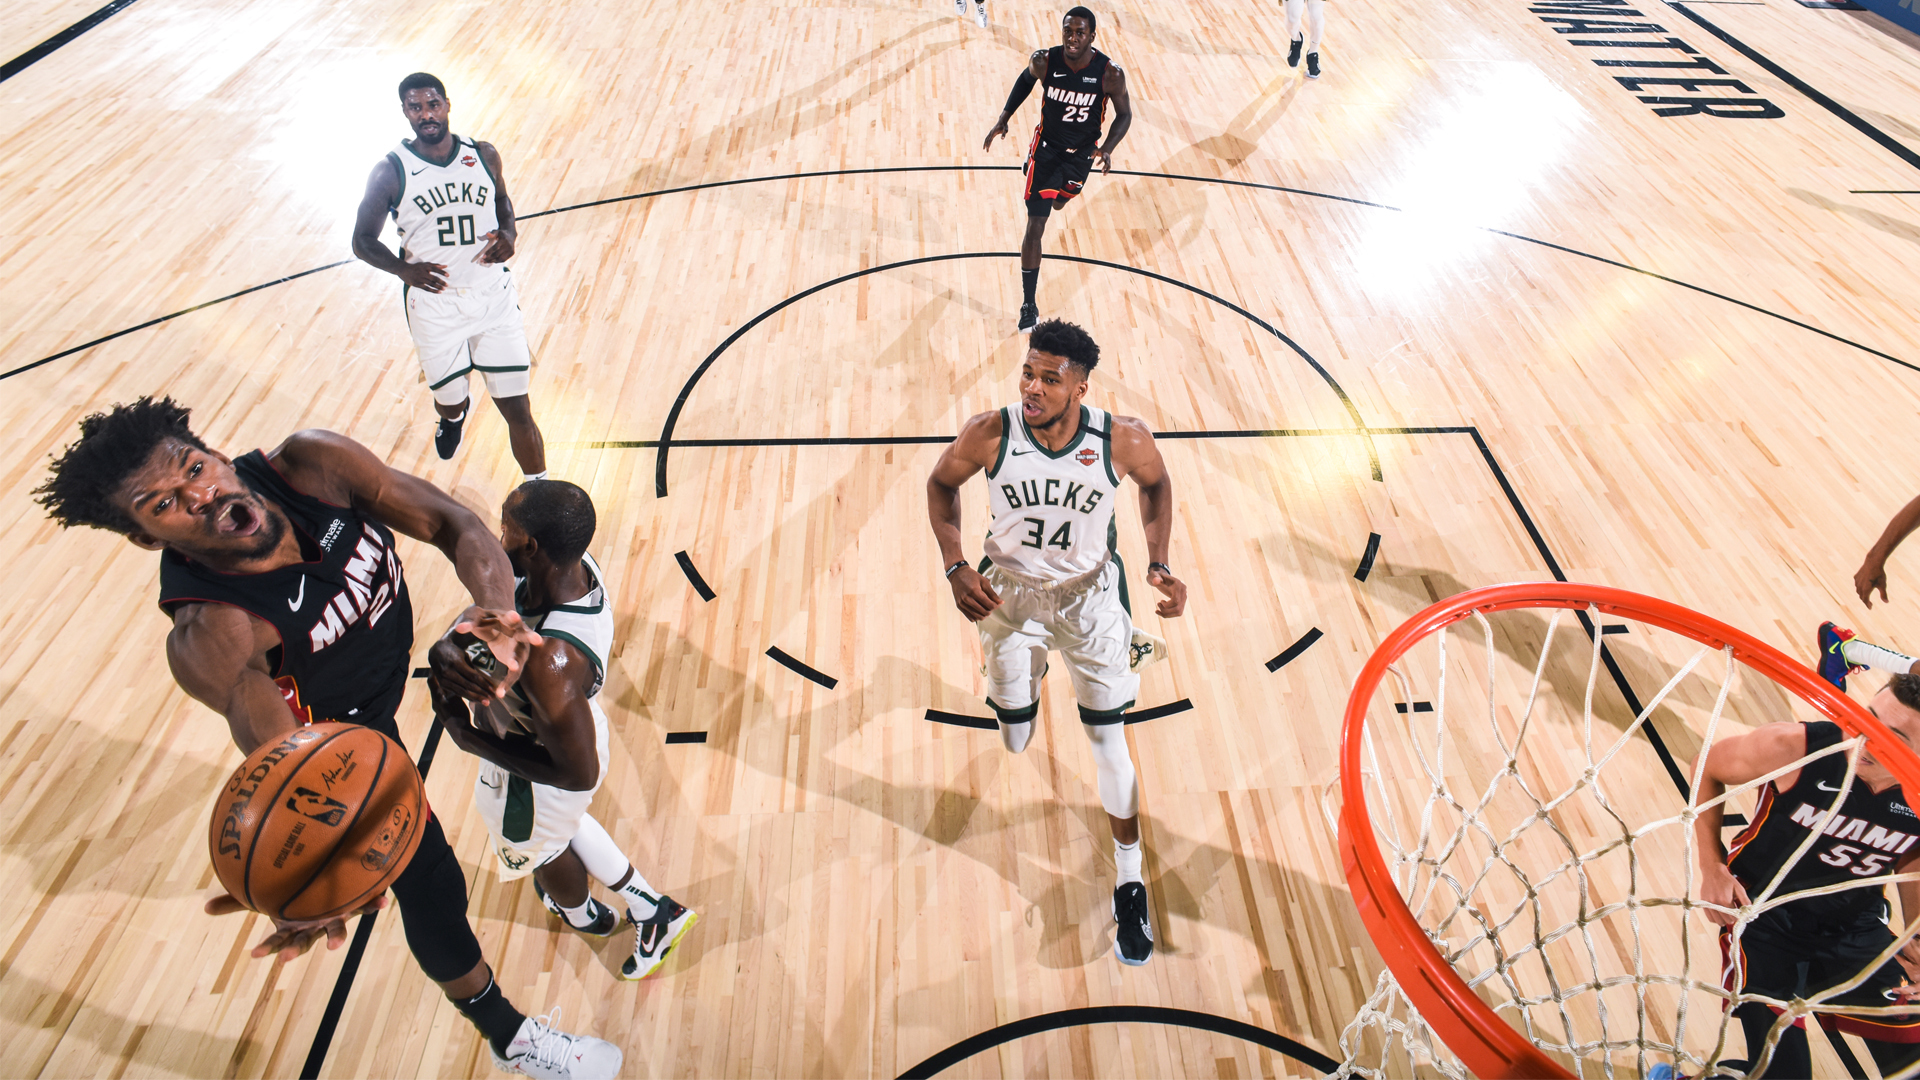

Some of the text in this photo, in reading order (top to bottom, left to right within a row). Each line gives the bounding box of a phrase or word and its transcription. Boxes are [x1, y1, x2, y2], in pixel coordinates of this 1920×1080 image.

[1527, 0, 1786, 118] MATTER
[1046, 85, 1097, 107] MIAMI
[1061, 105, 1090, 123] 25
[412, 182, 489, 216] BUCKS
[436, 214, 476, 247] 20
[1000, 478, 1104, 515] BUCKS
[325, 522, 346, 553] OFTWARE
[1020, 517, 1072, 551] 34
[308, 521, 385, 654] MIAMI
[367, 545, 402, 631] 22
[218, 729, 322, 861] SPALDING
[1890, 801, 1915, 814] Ultima
[291, 820, 306, 836] BALL
[1790, 802, 1920, 854] MIAMI
[1890, 808, 1918, 818] SOFTWAR
[1817, 843, 1896, 876] 55
